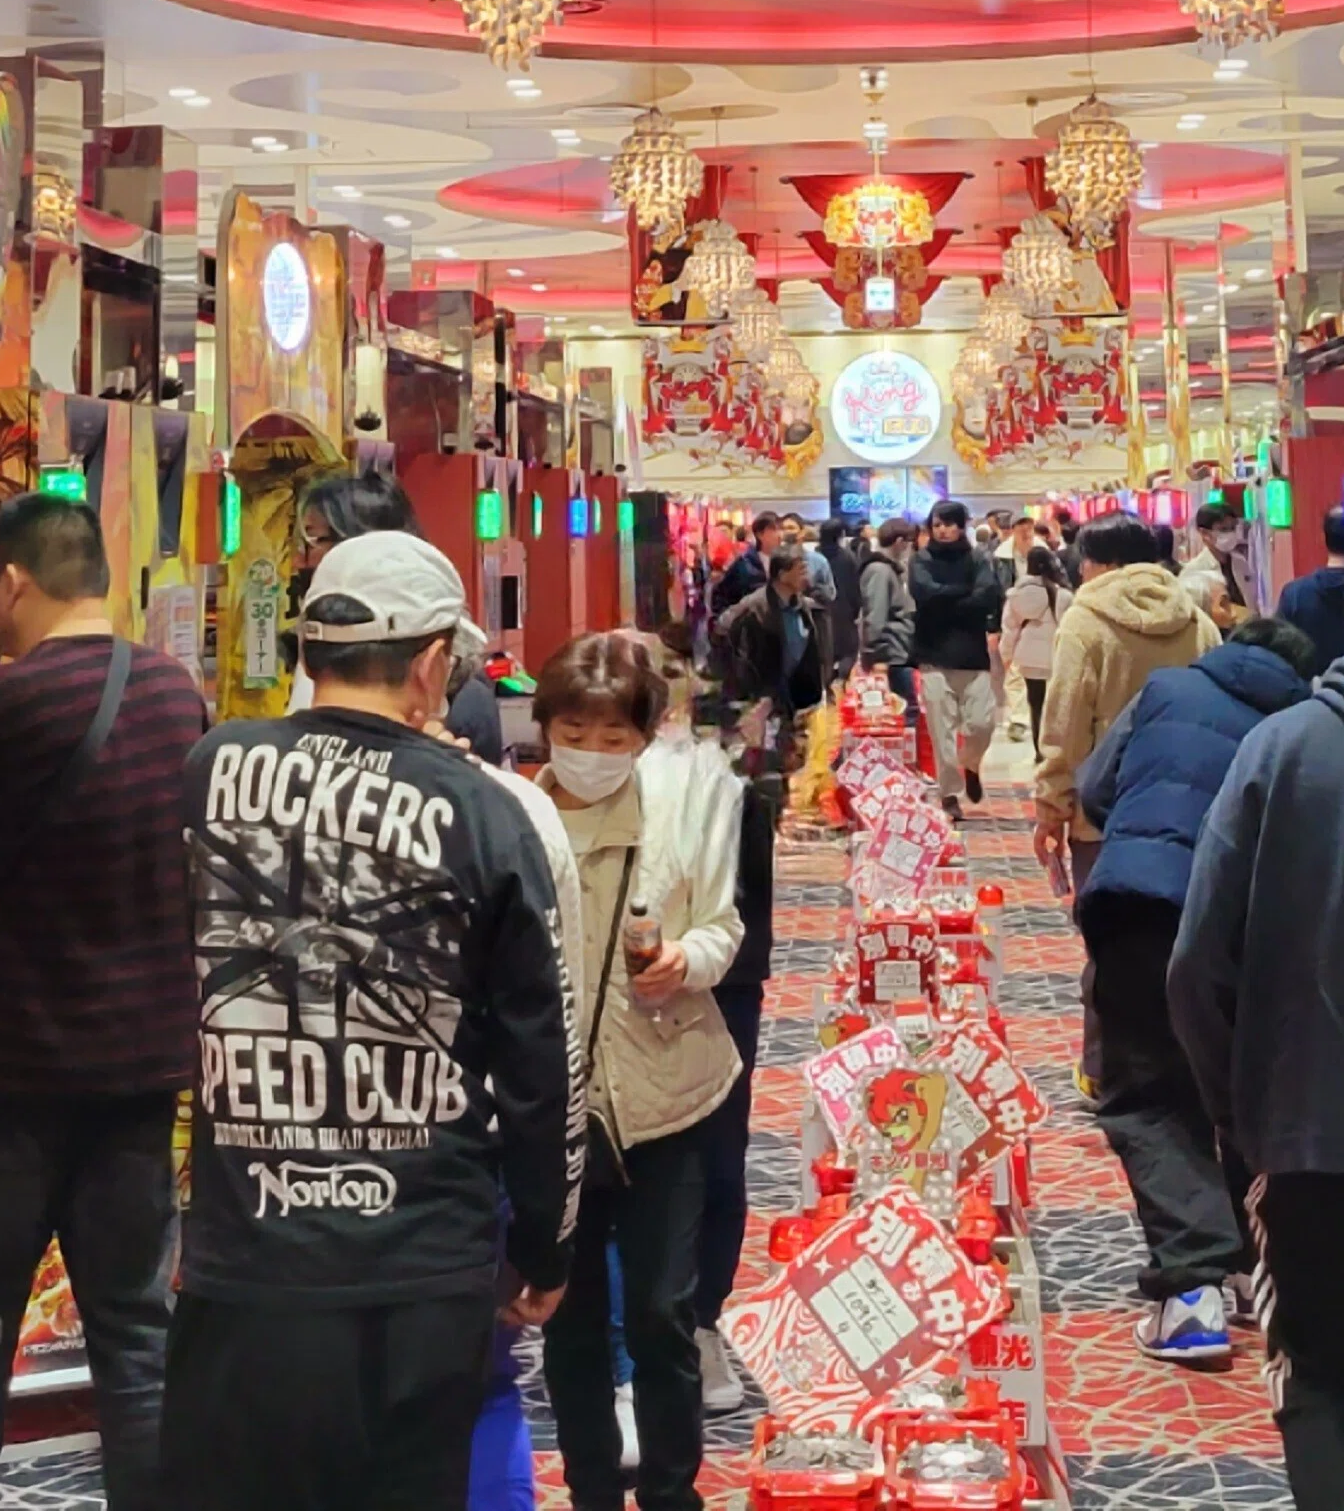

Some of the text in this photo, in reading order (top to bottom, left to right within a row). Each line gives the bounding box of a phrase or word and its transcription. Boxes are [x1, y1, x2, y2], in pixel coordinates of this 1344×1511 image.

[296, 733, 393, 773] ENGLAND
[206, 744, 455, 869] ROCKERS
[197, 1028, 469, 1125] PEED CLUB
[247, 1160, 399, 1219] Norton
